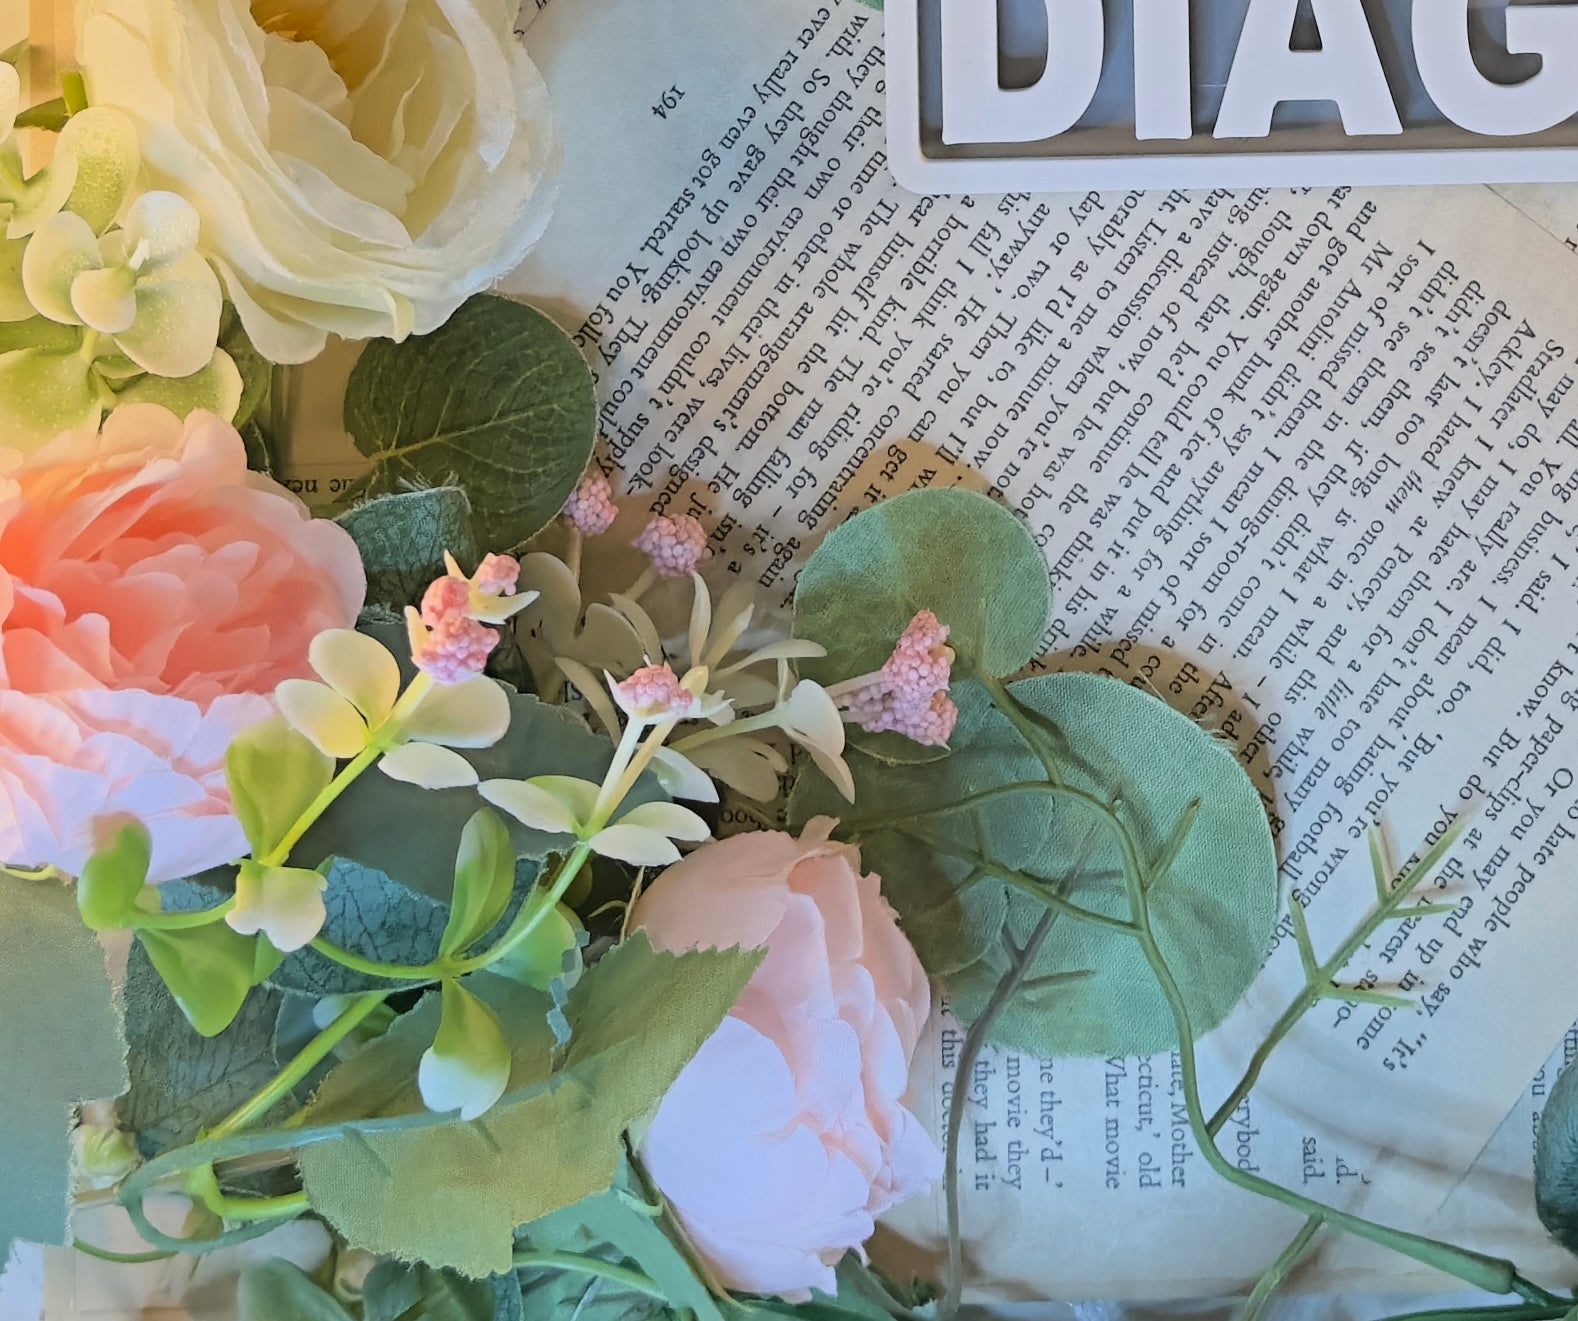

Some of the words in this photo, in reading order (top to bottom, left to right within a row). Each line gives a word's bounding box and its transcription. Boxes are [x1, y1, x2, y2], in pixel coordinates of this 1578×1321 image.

[650, 84, 685, 119] 194
[1359, 239, 1393, 275] Mr
[1296, 277, 1362, 357] Antolini
[1250, 362, 1301, 421] didn't
[1222, 423, 1251, 457] say
[1152, 460, 1224, 545] anything
[1131, 548, 1162, 581] for
[1116, 584, 1131, 597] a
[1067, 601, 1127, 670] while.
[1484, 712, 1563, 821] paper-clips
[1462, 827, 1482, 850] at
[1532, 822, 1575, 865] hate
[1433, 857, 1464, 890] the
[1483, 861, 1535, 932] people
[1448, 937, 1487, 979] who
[1415, 982, 1450, 1017] say,
[967, 1061, 996, 1109] they
[1006, 1056, 1027, 1128] movie
[974, 1121, 997, 1163] had
[974, 1173, 995, 1190] it
[1000, 1140, 1029, 1190] they
[1138, 1151, 1161, 1188] old
